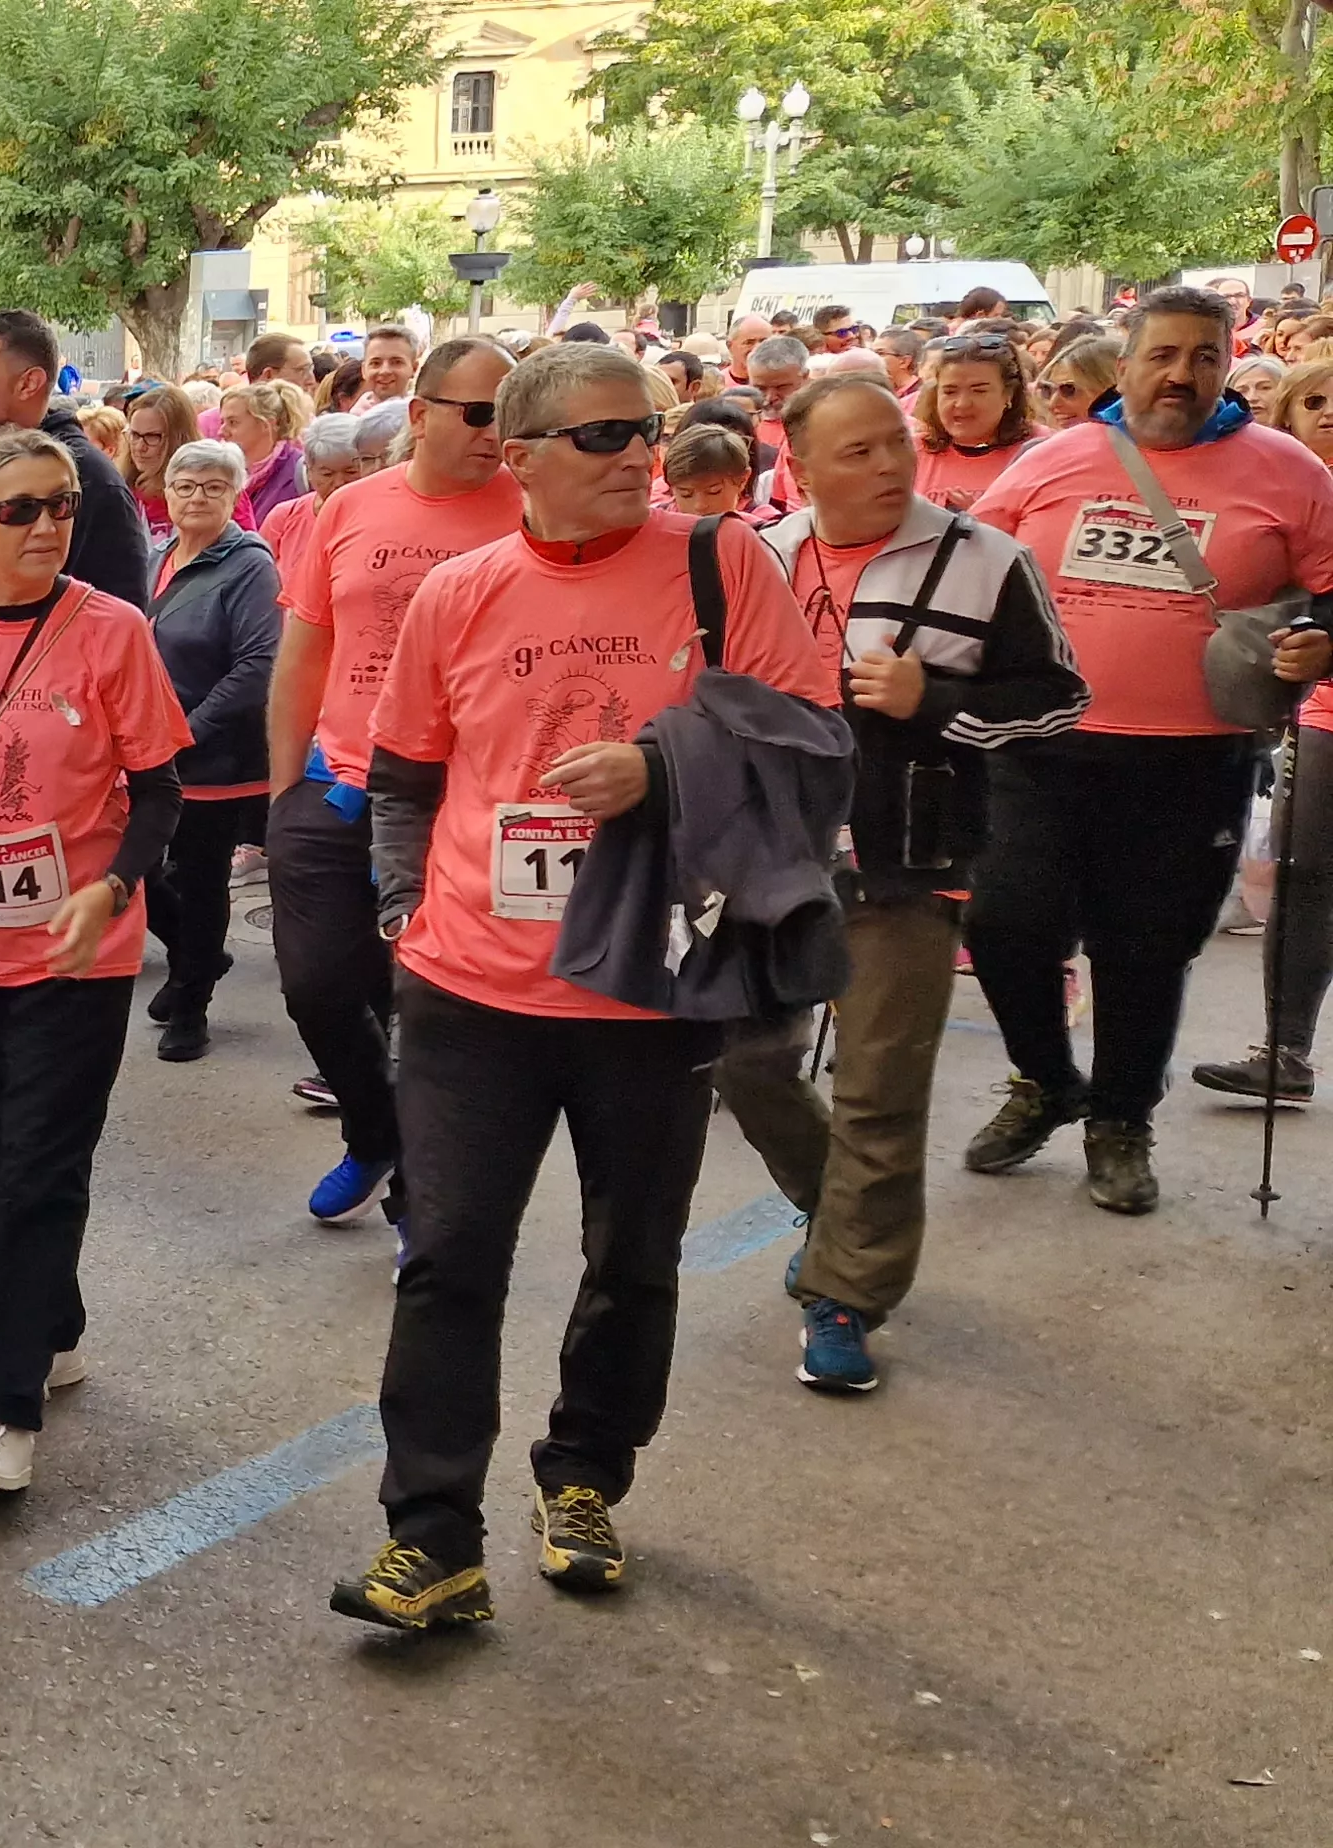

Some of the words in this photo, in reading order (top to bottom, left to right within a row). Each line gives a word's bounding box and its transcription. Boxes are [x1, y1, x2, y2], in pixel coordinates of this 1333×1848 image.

[401, 545, 464, 561] CÁNCE
[515, 647, 543, 677] 9ª
[549, 634, 640, 656] CÁNCER
[595, 653, 658, 665] HUESCA
[551, 818, 596, 828] HUESCA
[508, 828, 563, 840] CONTRA
[566, 829, 583, 840] EL
[1, 845, 49, 863] CÁNCER
[524, 848, 587, 891] 11
